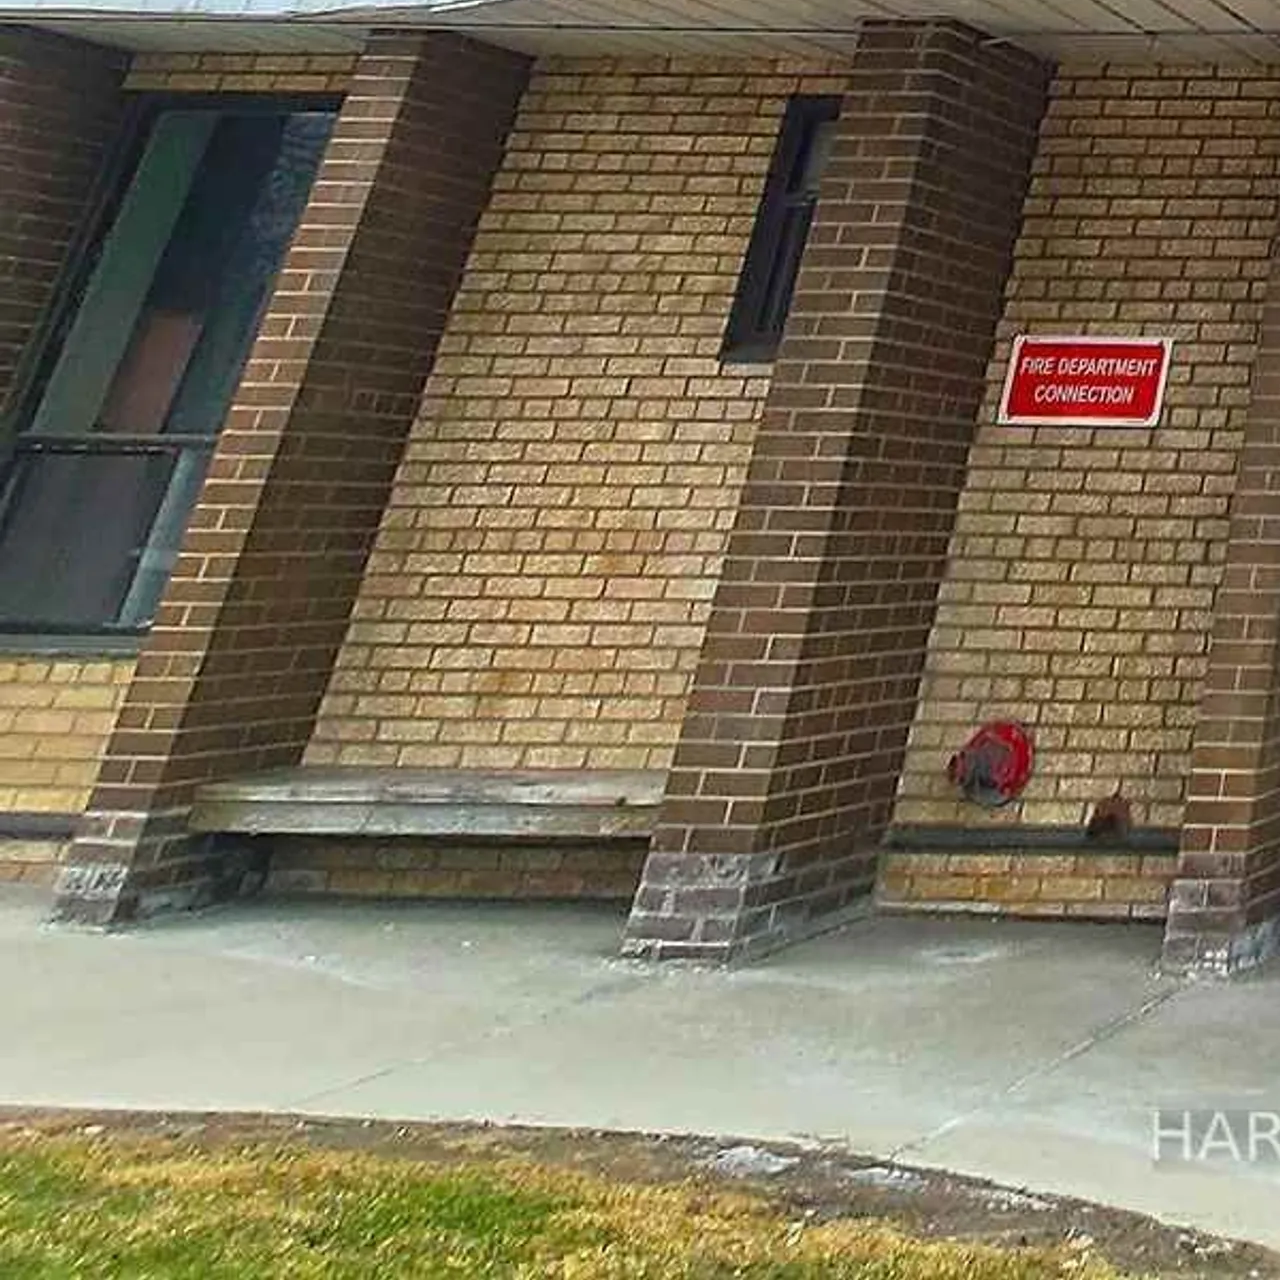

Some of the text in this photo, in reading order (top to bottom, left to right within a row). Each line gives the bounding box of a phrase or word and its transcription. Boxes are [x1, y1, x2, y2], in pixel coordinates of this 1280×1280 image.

[1019, 356, 1158, 377] FIRE DEPARTMENT
[1033, 384, 1135, 405] CONNECTION
